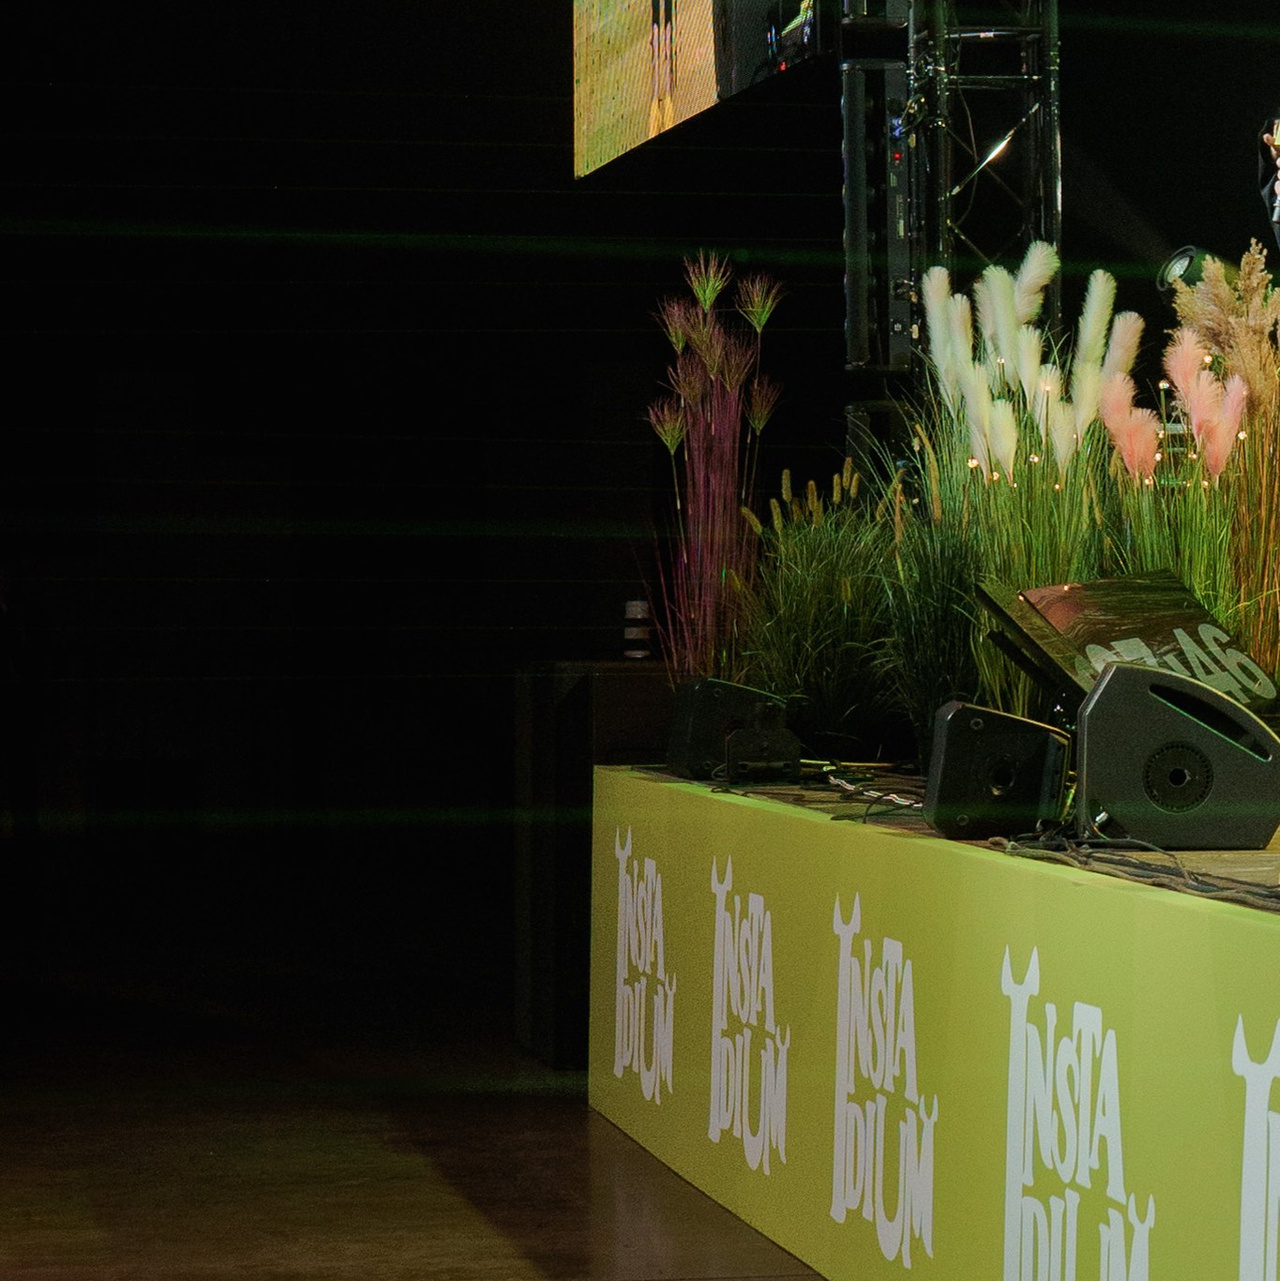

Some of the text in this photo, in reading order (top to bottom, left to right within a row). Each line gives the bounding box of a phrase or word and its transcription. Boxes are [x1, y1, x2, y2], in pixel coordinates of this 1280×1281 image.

[614, 825, 664, 1078] INSTA
[709, 854, 775, 1143] INSTA
[830, 892, 918, 1223] INSTA
